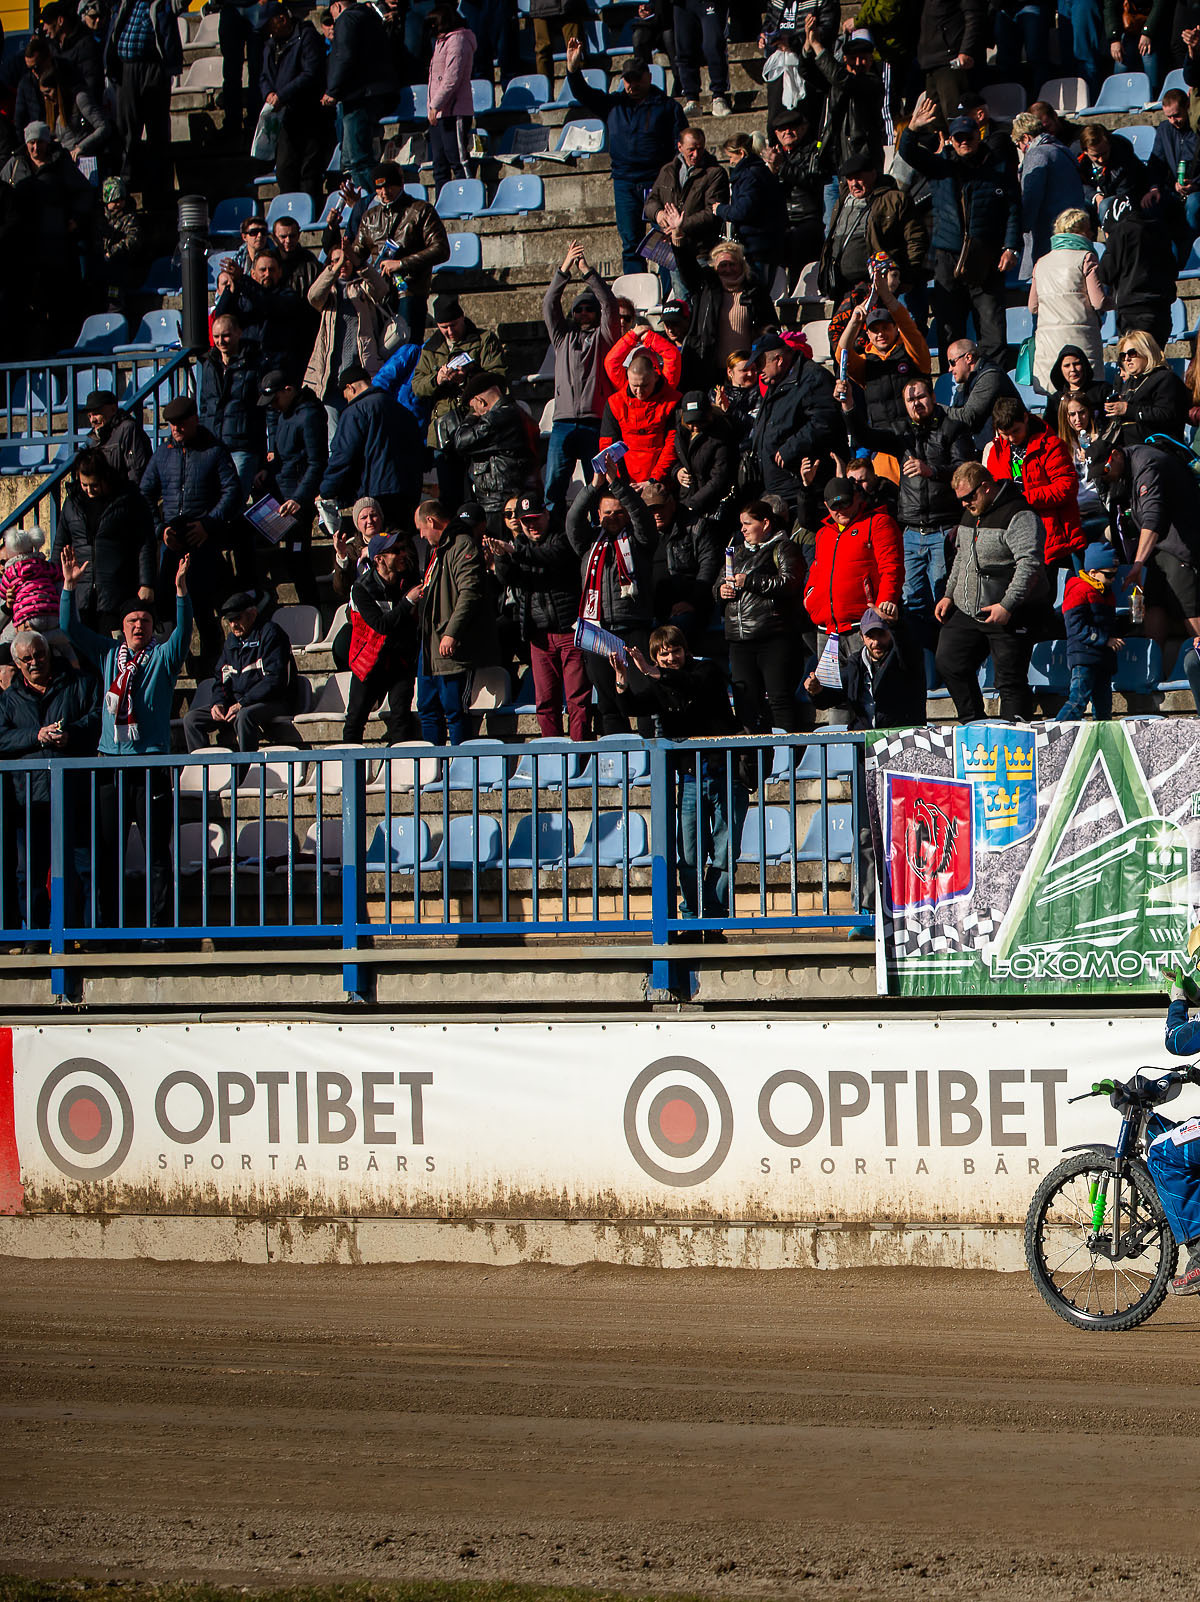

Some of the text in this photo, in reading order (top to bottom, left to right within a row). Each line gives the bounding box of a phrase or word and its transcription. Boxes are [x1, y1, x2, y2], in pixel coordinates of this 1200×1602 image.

[831, 818, 845, 831] 12
[155, 1071, 433, 1145] OPTIBET
[758, 1069, 1067, 1147] OPTIBET
[158, 1151, 436, 1172] SPORTA BĀRS
[761, 1154, 1067, 1175] SPORTA BĀR
